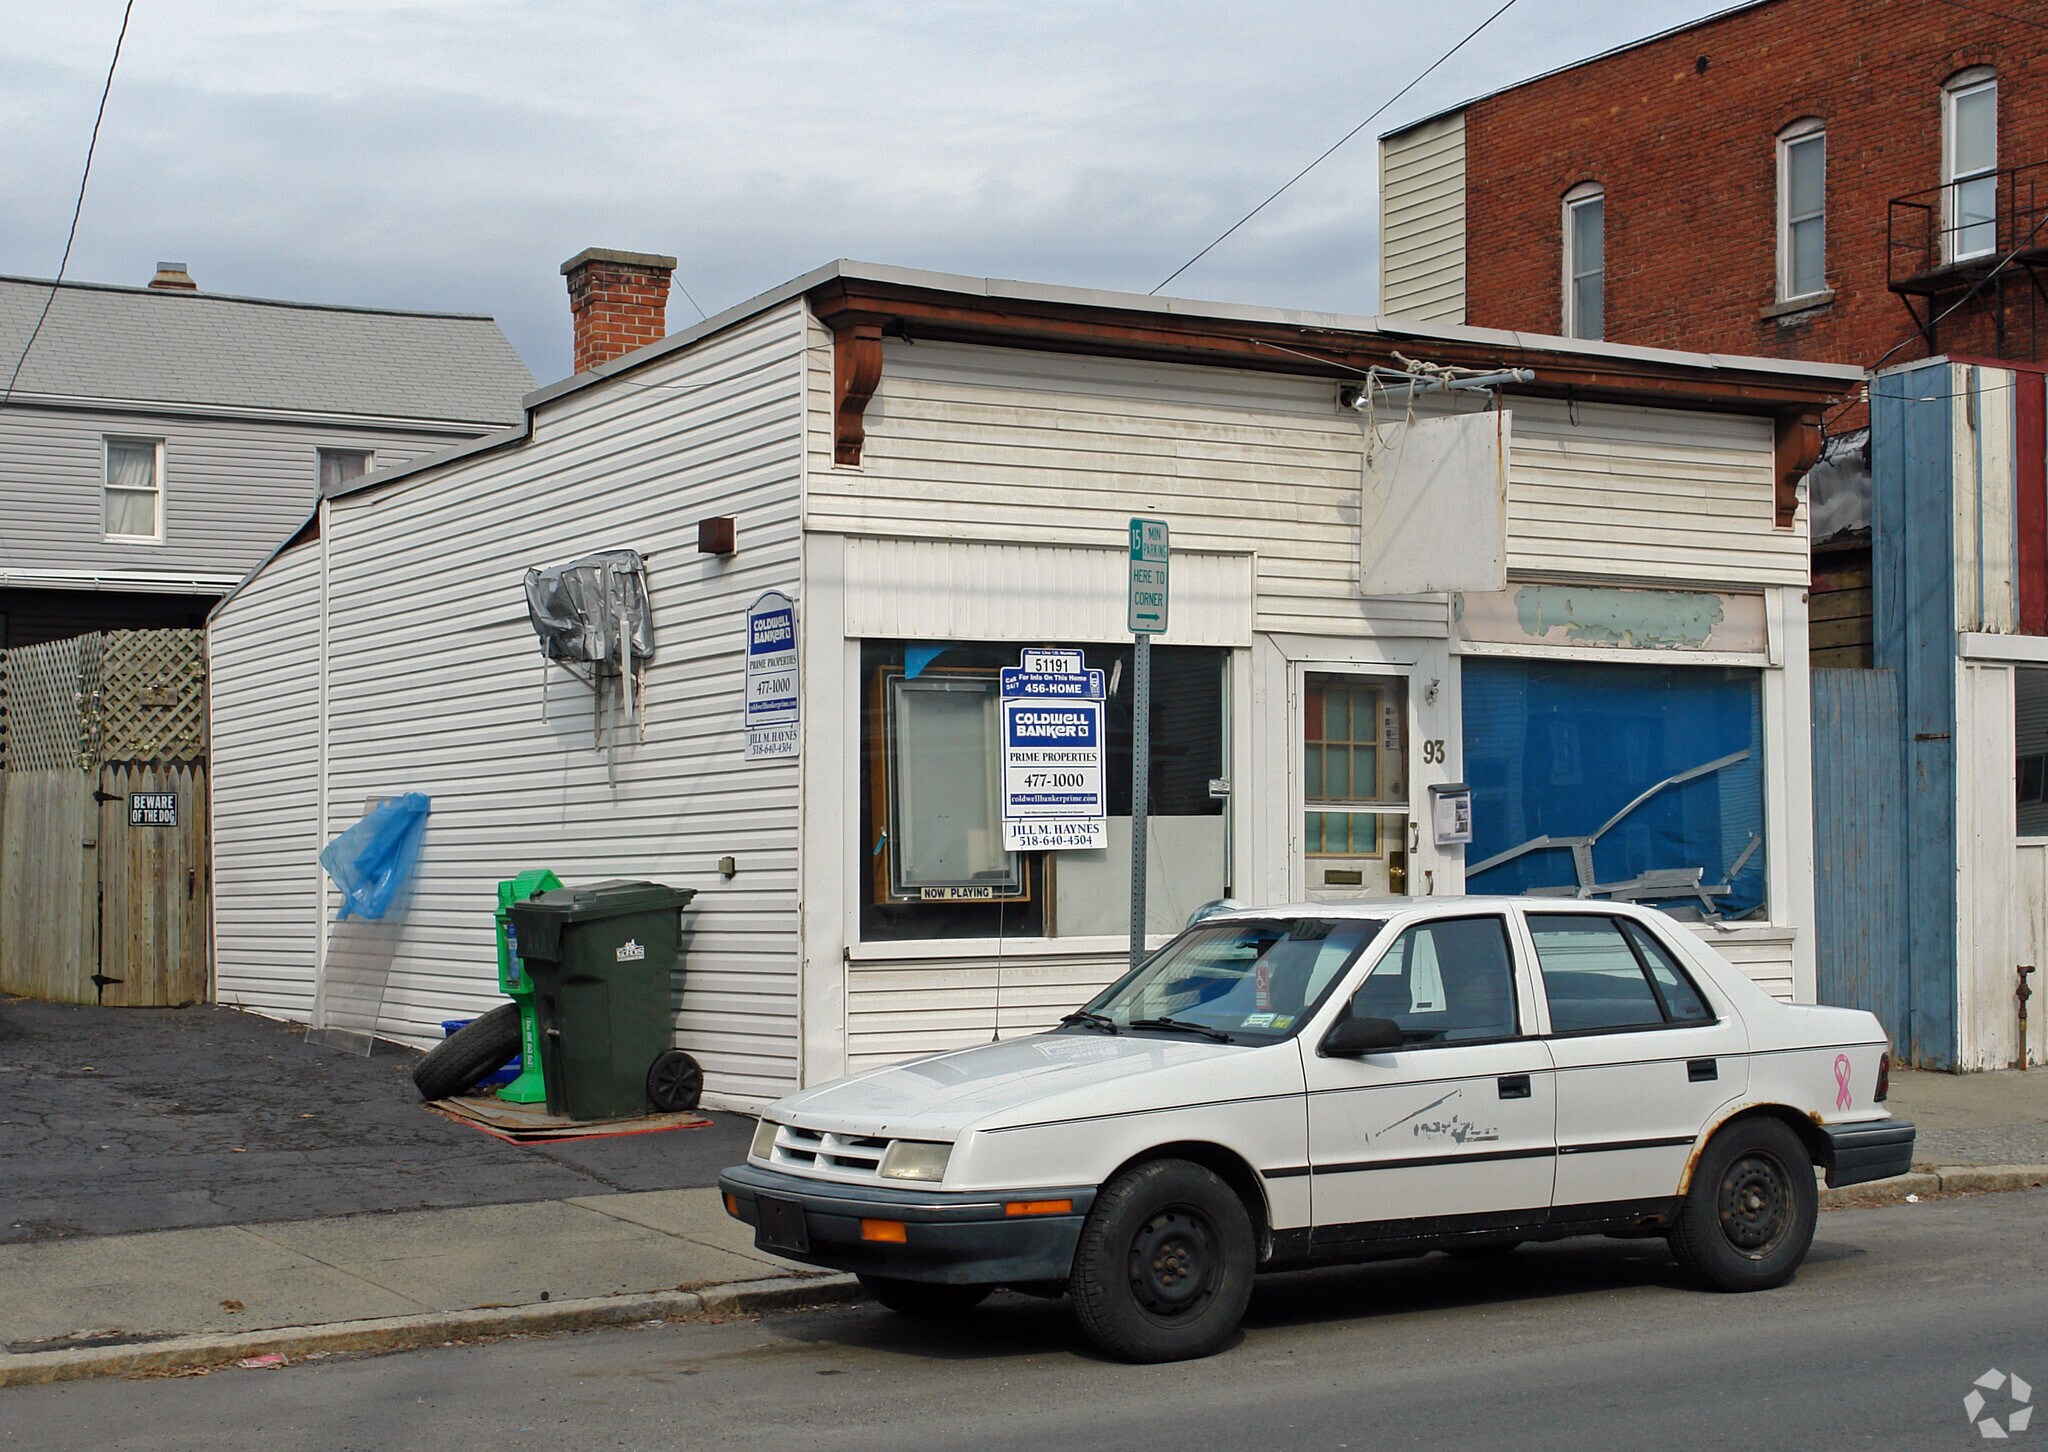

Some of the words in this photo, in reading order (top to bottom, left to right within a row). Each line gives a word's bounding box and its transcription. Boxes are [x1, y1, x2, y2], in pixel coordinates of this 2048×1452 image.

[1132, 528, 1141, 550] 15
[1147, 527, 1161, 541] MIN
[1143, 542, 1167, 559] PARKING
[1133, 569, 1152, 584] HERE
[1155, 570, 1165, 584] TO
[1134, 591, 1163, 606] CORNER
[749, 658, 766, 670] PRIME
[767, 655, 797, 668] PROPERTIES
[1035, 658, 1068, 672] 51191
[757, 678, 791, 696] 477-1000
[1024, 684, 1082, 694] 456-HOME
[748, 732, 761, 747] JILL
[772, 730, 798, 742] HAYNES
[752, 742, 792, 756] 518-640-4504
[1423, 739, 1446, 765] 93
[1010, 752, 1040, 762] PRIME
[1042, 752, 1098, 762] PROPERTIES
[1024, 773, 1084, 788] 477-1000
[133, 795, 174, 809] BEWARE
[1011, 794, 1098, 804] coldwellbankerprime.com
[132, 810, 142, 822] OF
[143, 810, 158, 822] THE
[158, 810, 175, 822] DOG
[1010, 825, 1036, 838] JILL
[1038, 824, 1052, 835] M.
[1054, 824, 1100, 834] HAYNES
[1019, 834, 1093, 846] 518-640-4504
[924, 888, 946, 898] NOW
[950, 888, 990, 898] PLAYING
[525, 1020, 534, 1066] FREE
